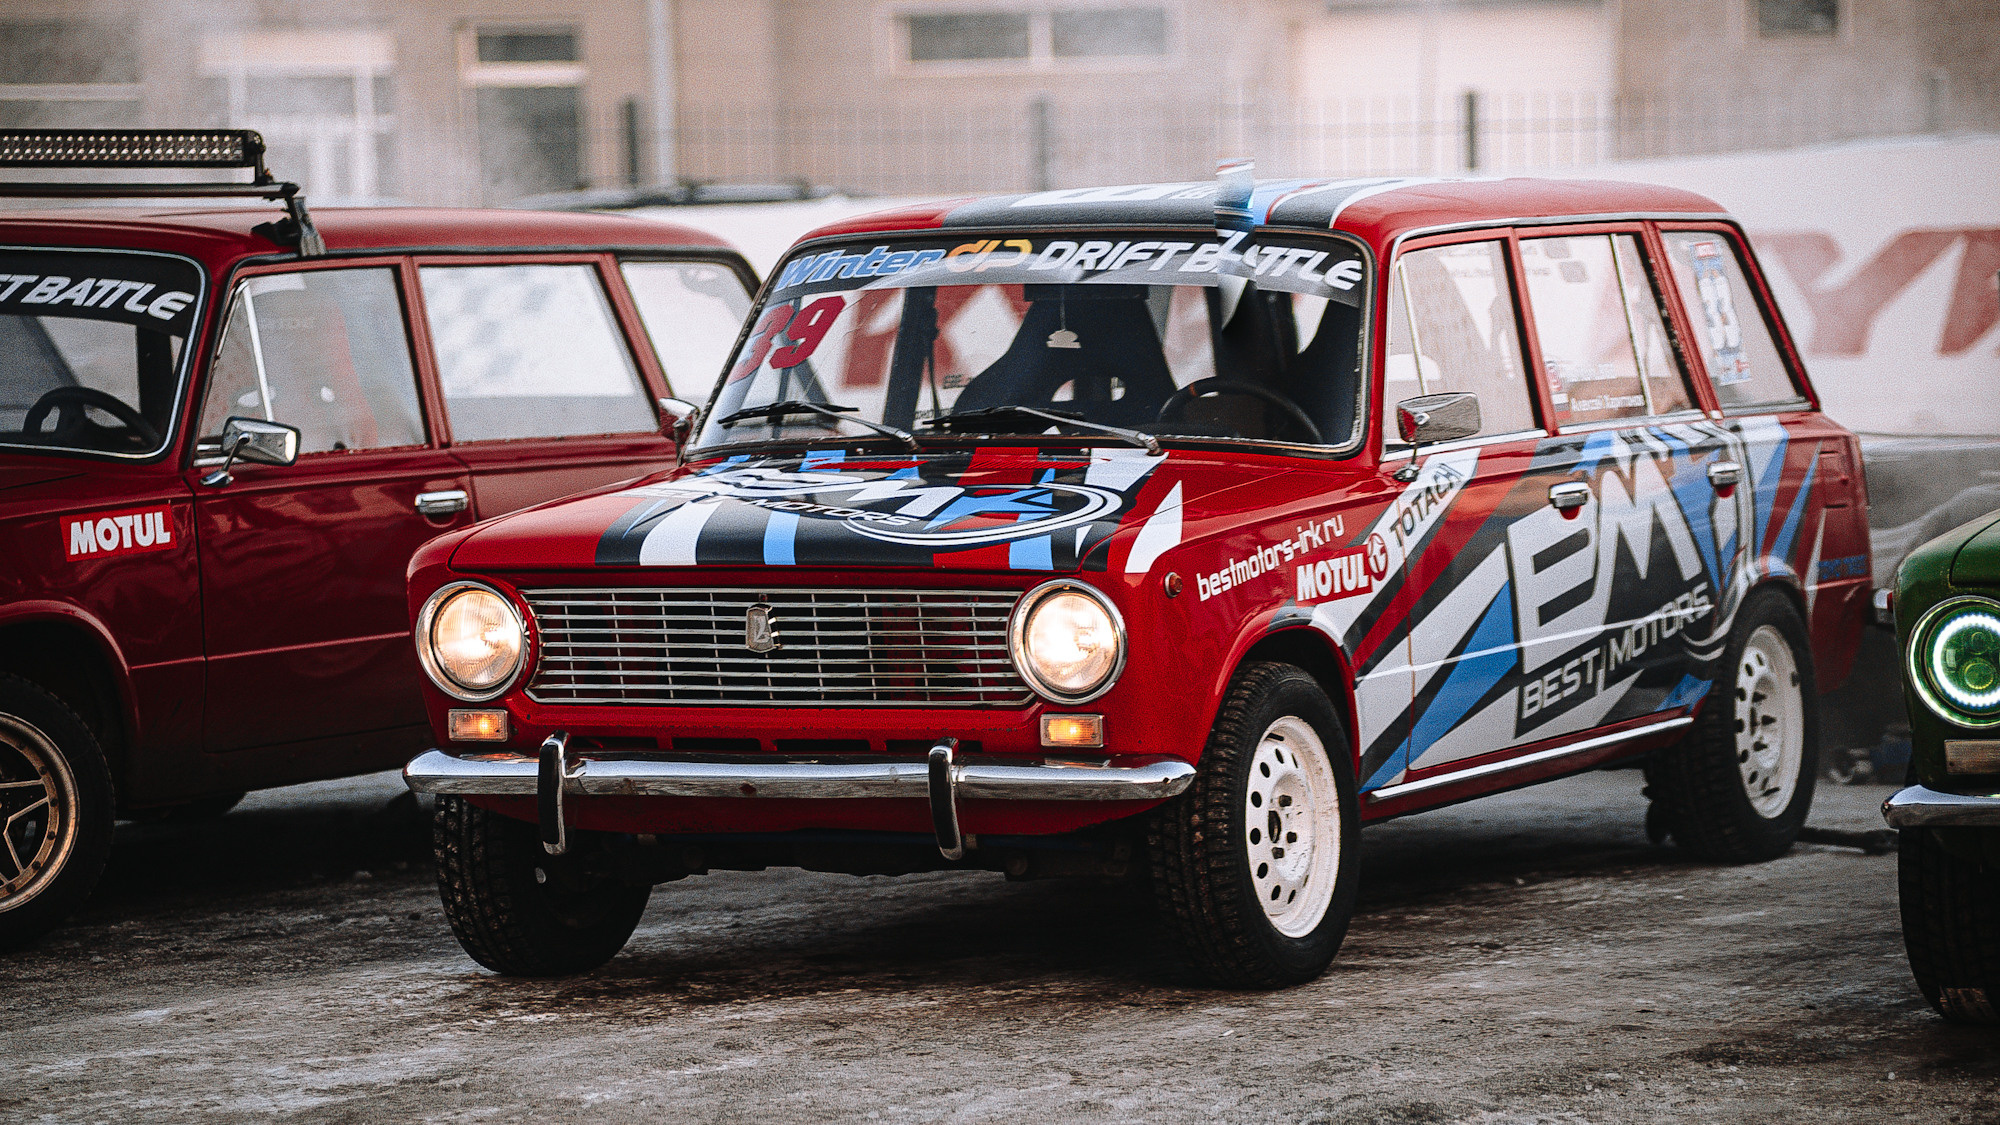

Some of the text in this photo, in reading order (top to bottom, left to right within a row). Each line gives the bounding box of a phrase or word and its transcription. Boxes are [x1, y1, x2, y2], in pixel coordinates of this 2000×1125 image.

[773, 246, 946, 292] Winter
[1028, 240, 1196, 272] DRIFT
[1178, 230, 1363, 291] BTTLE
[0, 274, 195, 321] T BATTLE
[727, 295, 846, 386] 39
[70, 511, 171, 555] MOTUL
[1390, 463, 1463, 547] TOTACHI
[1297, 553, 1369, 601] MOTUL
[1522, 581, 1711, 720] BEST MOTORS
